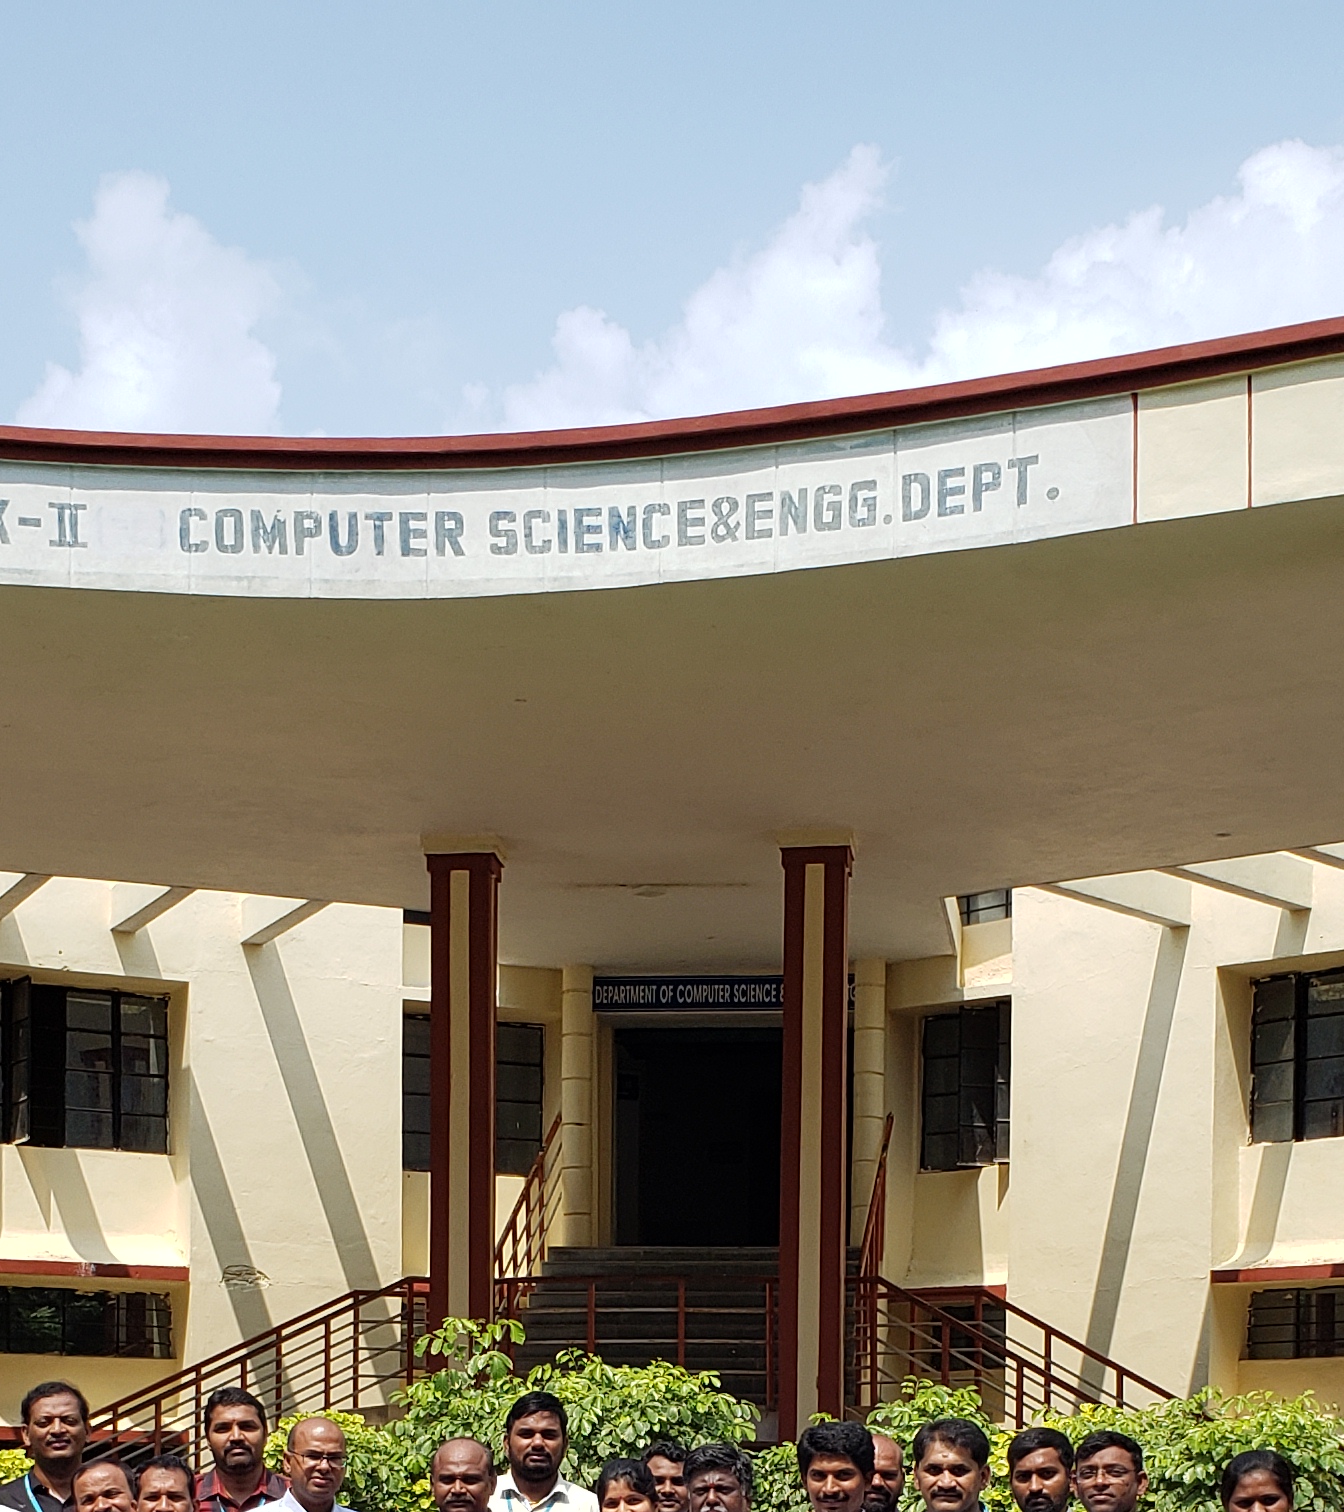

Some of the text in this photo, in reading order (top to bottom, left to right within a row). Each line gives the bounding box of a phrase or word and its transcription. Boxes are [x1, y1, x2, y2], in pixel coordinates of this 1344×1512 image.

[178, 506, 467, 557] COMPUTER
[595, 985, 658, 1004] DEPARTMENT
[659, 985, 674, 1004] OF
[676, 984, 730, 1003] COMPUTER
[733, 984, 777, 1003] SCIENCE
